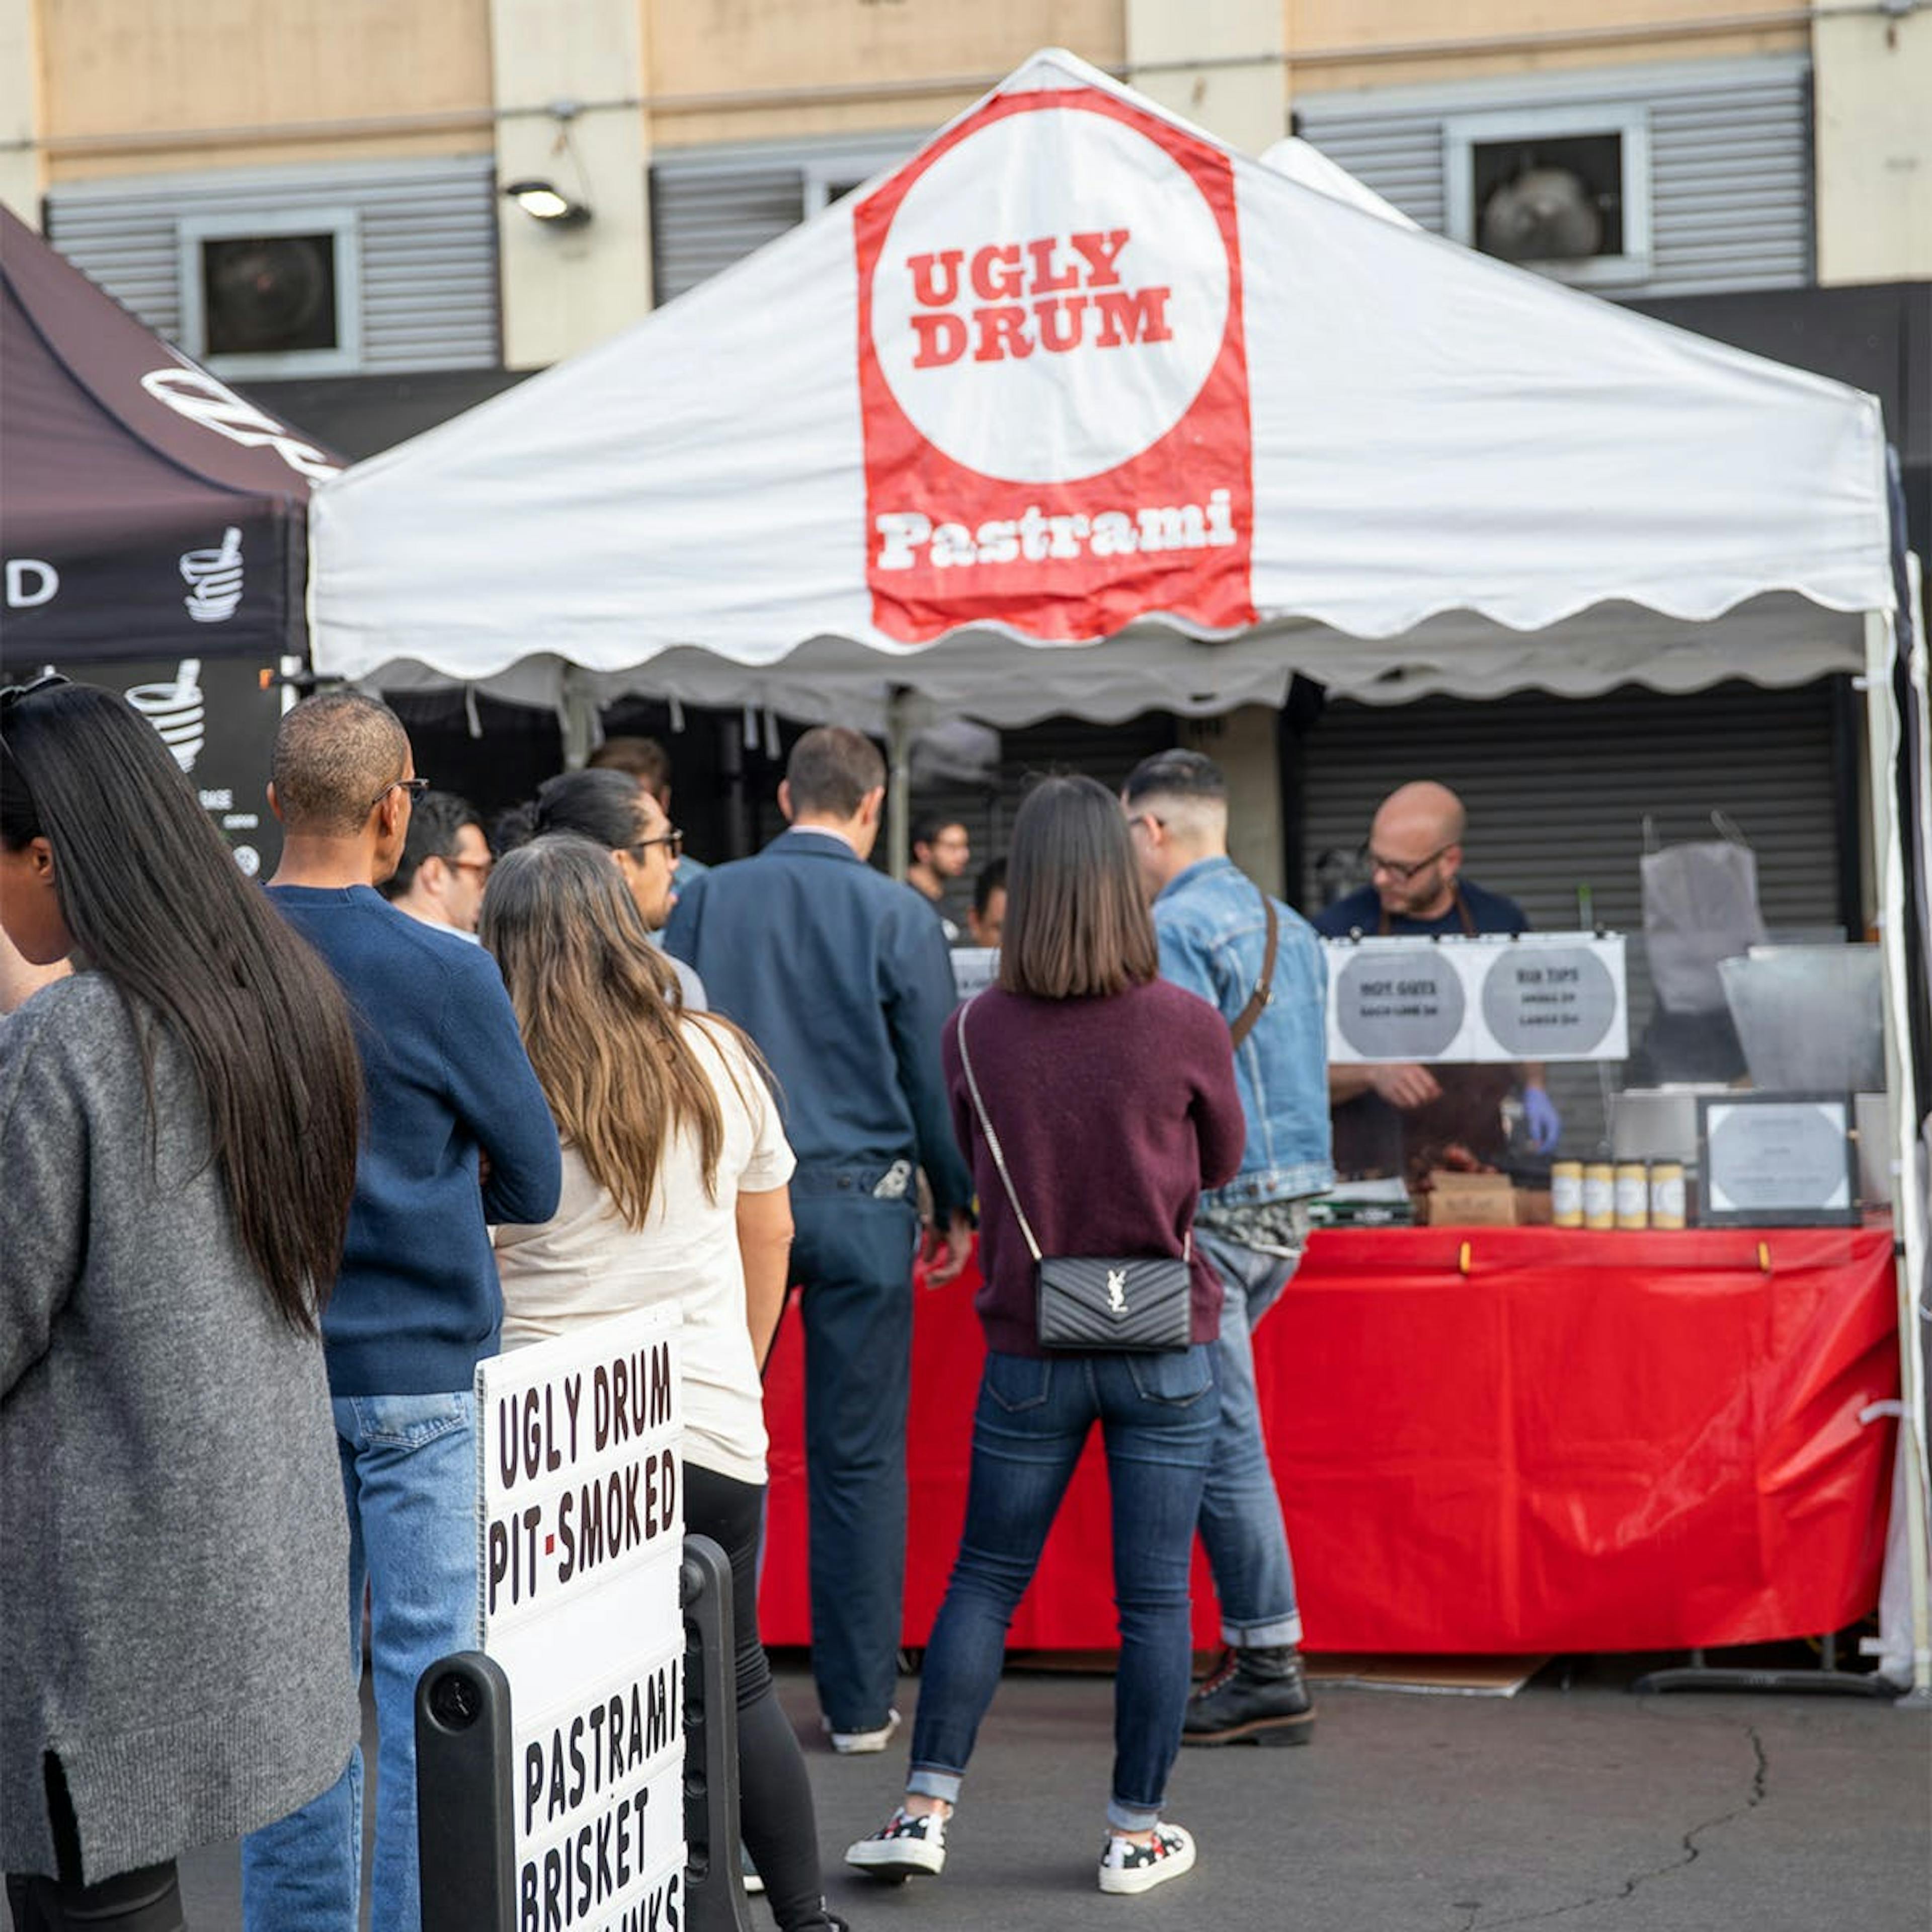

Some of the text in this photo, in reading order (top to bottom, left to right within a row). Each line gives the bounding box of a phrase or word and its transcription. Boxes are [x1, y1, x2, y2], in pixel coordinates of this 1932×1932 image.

[907, 229, 1131, 308] UGLY
[910, 287, 1173, 369] DRUM
[876, 489, 1237, 570] Pastrami
[500, 1341, 671, 1489] UGLY DRUM
[489, 1449, 675, 1615] PIT-SMOKED
[525, 1659, 676, 1836] PASTRAMI
[521, 1787, 648, 1932] BRISKET
